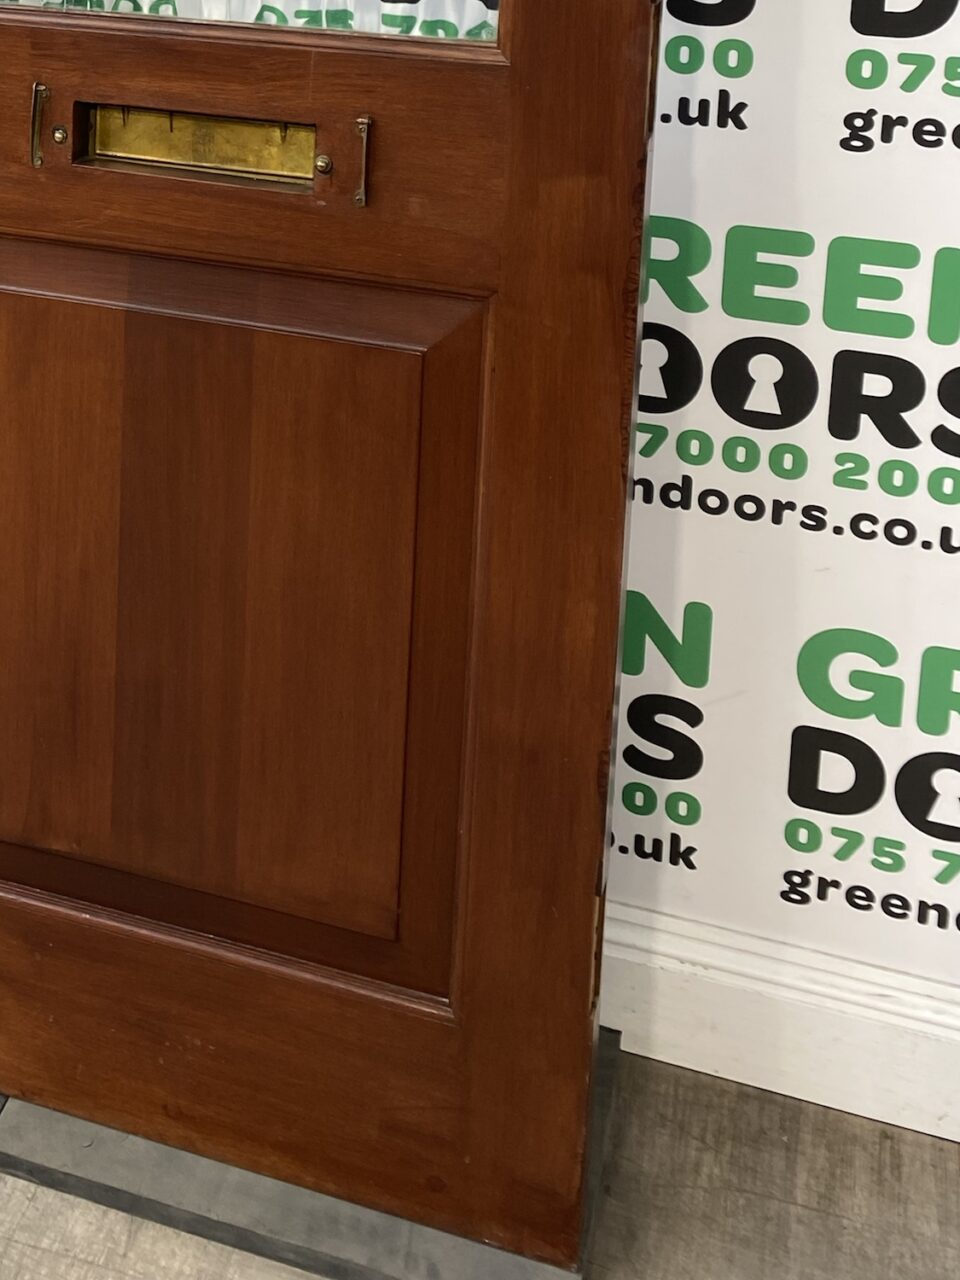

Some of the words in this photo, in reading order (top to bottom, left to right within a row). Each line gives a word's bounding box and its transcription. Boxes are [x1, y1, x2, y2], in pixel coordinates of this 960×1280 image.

[839, 108, 960, 153] gre
[635, 423, 808, 481] 7000
[784, 818, 907, 874] 075
[611, 832, 698, 870] .uk
[780, 869, 960, 932] green
